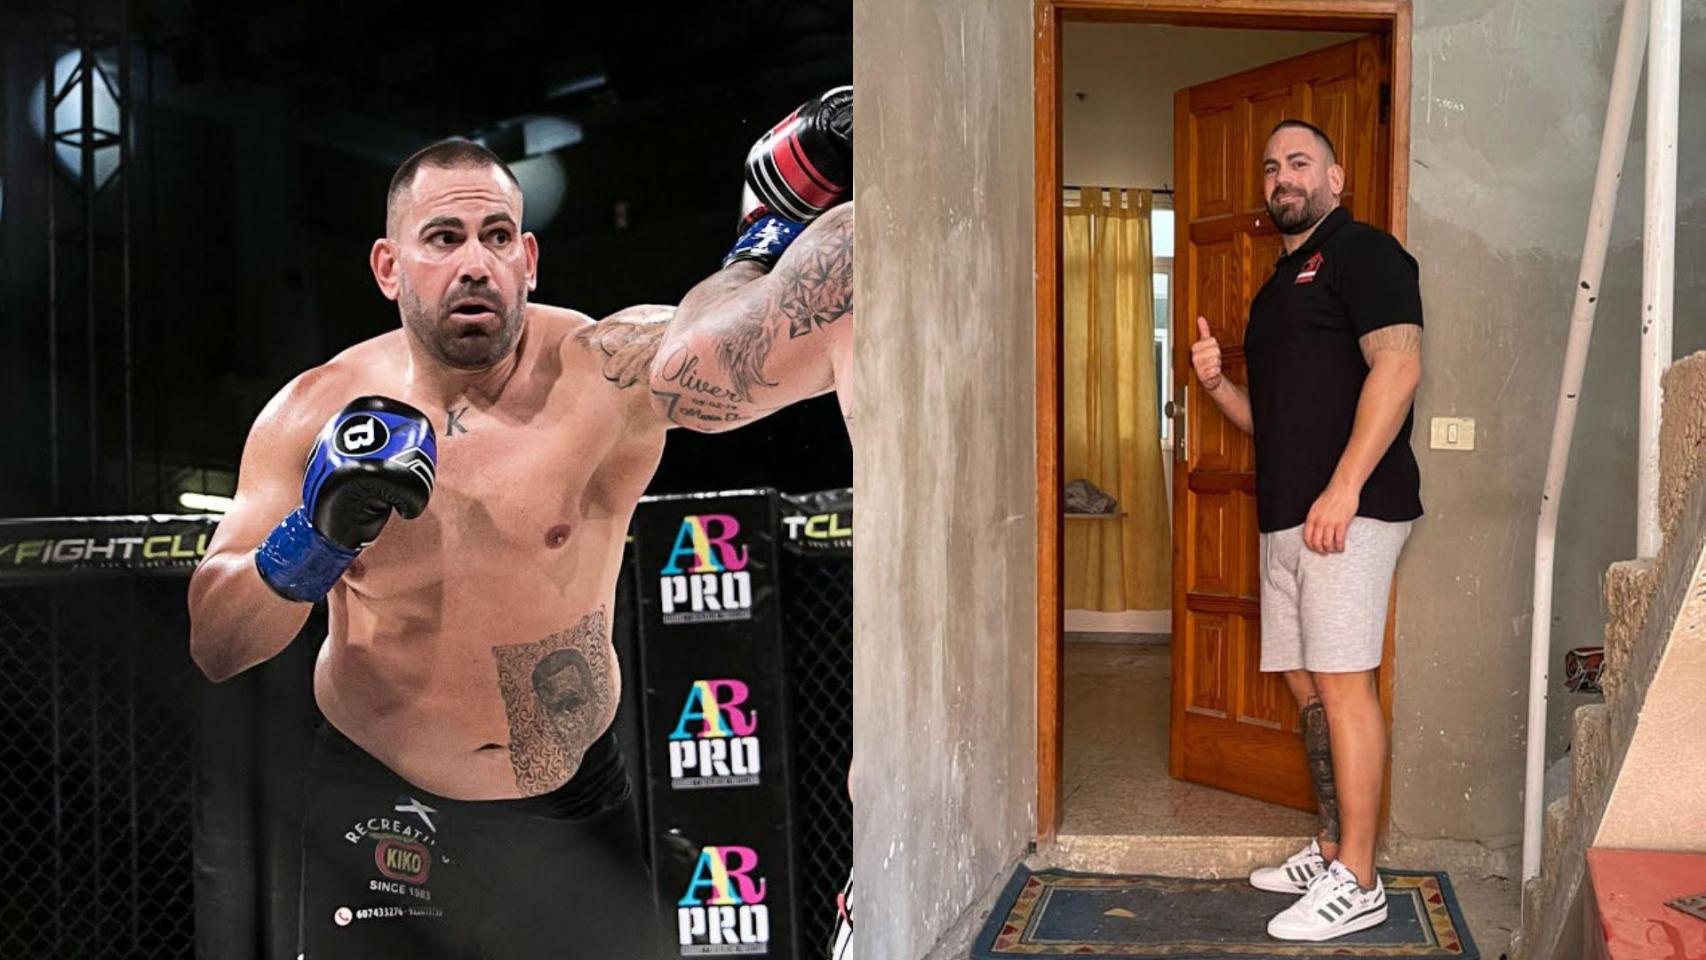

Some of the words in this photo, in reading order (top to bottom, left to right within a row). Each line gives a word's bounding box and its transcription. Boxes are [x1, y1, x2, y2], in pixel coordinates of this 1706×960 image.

[662, 345, 742, 403] Oliver
[444, 406, 468, 436] K
[661, 514, 749, 575] AR
[660, 571, 752, 614] PRO
[668, 679, 758, 739] AR
[669, 736, 761, 778] PRO
[386, 847, 421, 873] KIKO
[678, 846, 767, 906] AR
[369, 880, 406, 895] SINCE
[678, 904, 770, 945] PRO
